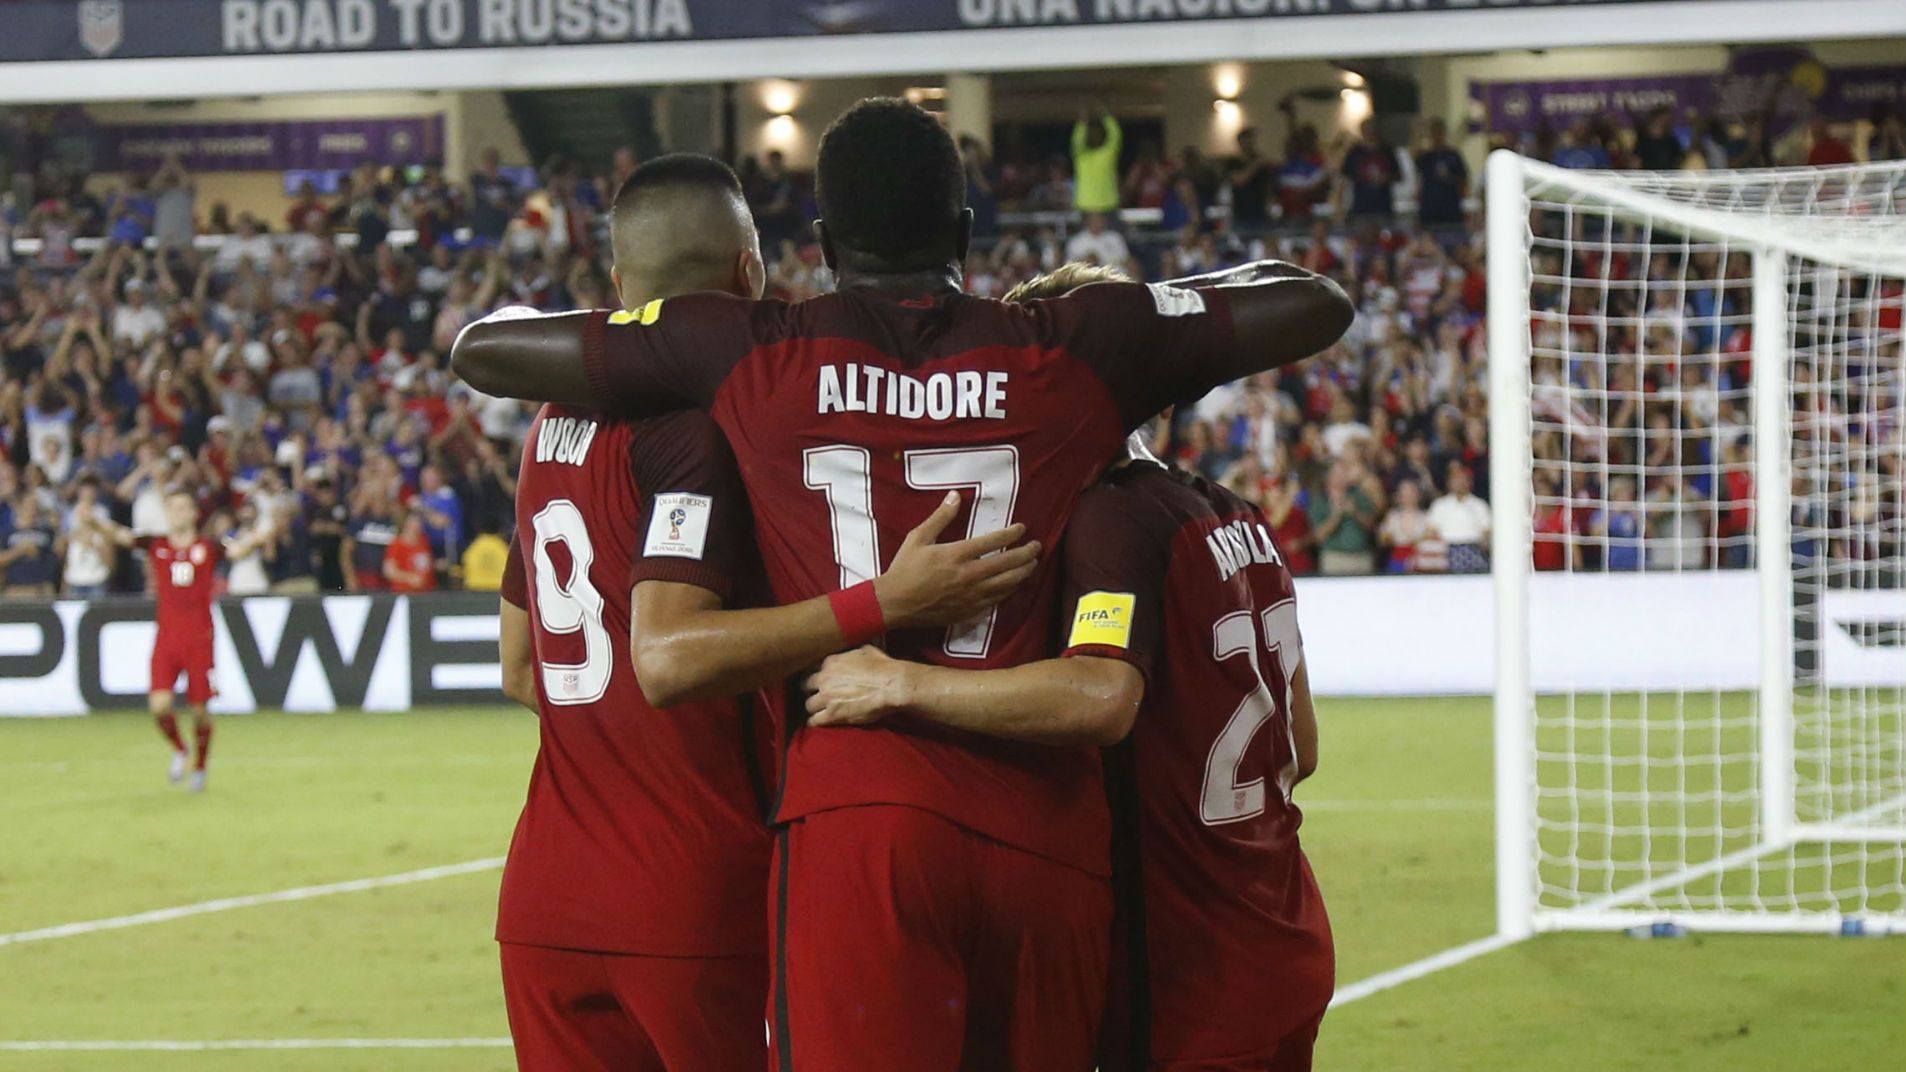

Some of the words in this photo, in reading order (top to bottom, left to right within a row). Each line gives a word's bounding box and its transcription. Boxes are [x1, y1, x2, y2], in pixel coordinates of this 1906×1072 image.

[222, 0, 377, 52] ROAD
[391, 0, 464, 46] TO
[478, 0, 692, 42] RUSSIA
[818, 363, 1008, 420] ALTIDORE
[532, 499, 613, 706] 9
[803, 444, 1020, 659] 17
[1079, 609, 1109, 623] FIFA
[1200, 597, 1300, 826] 21
